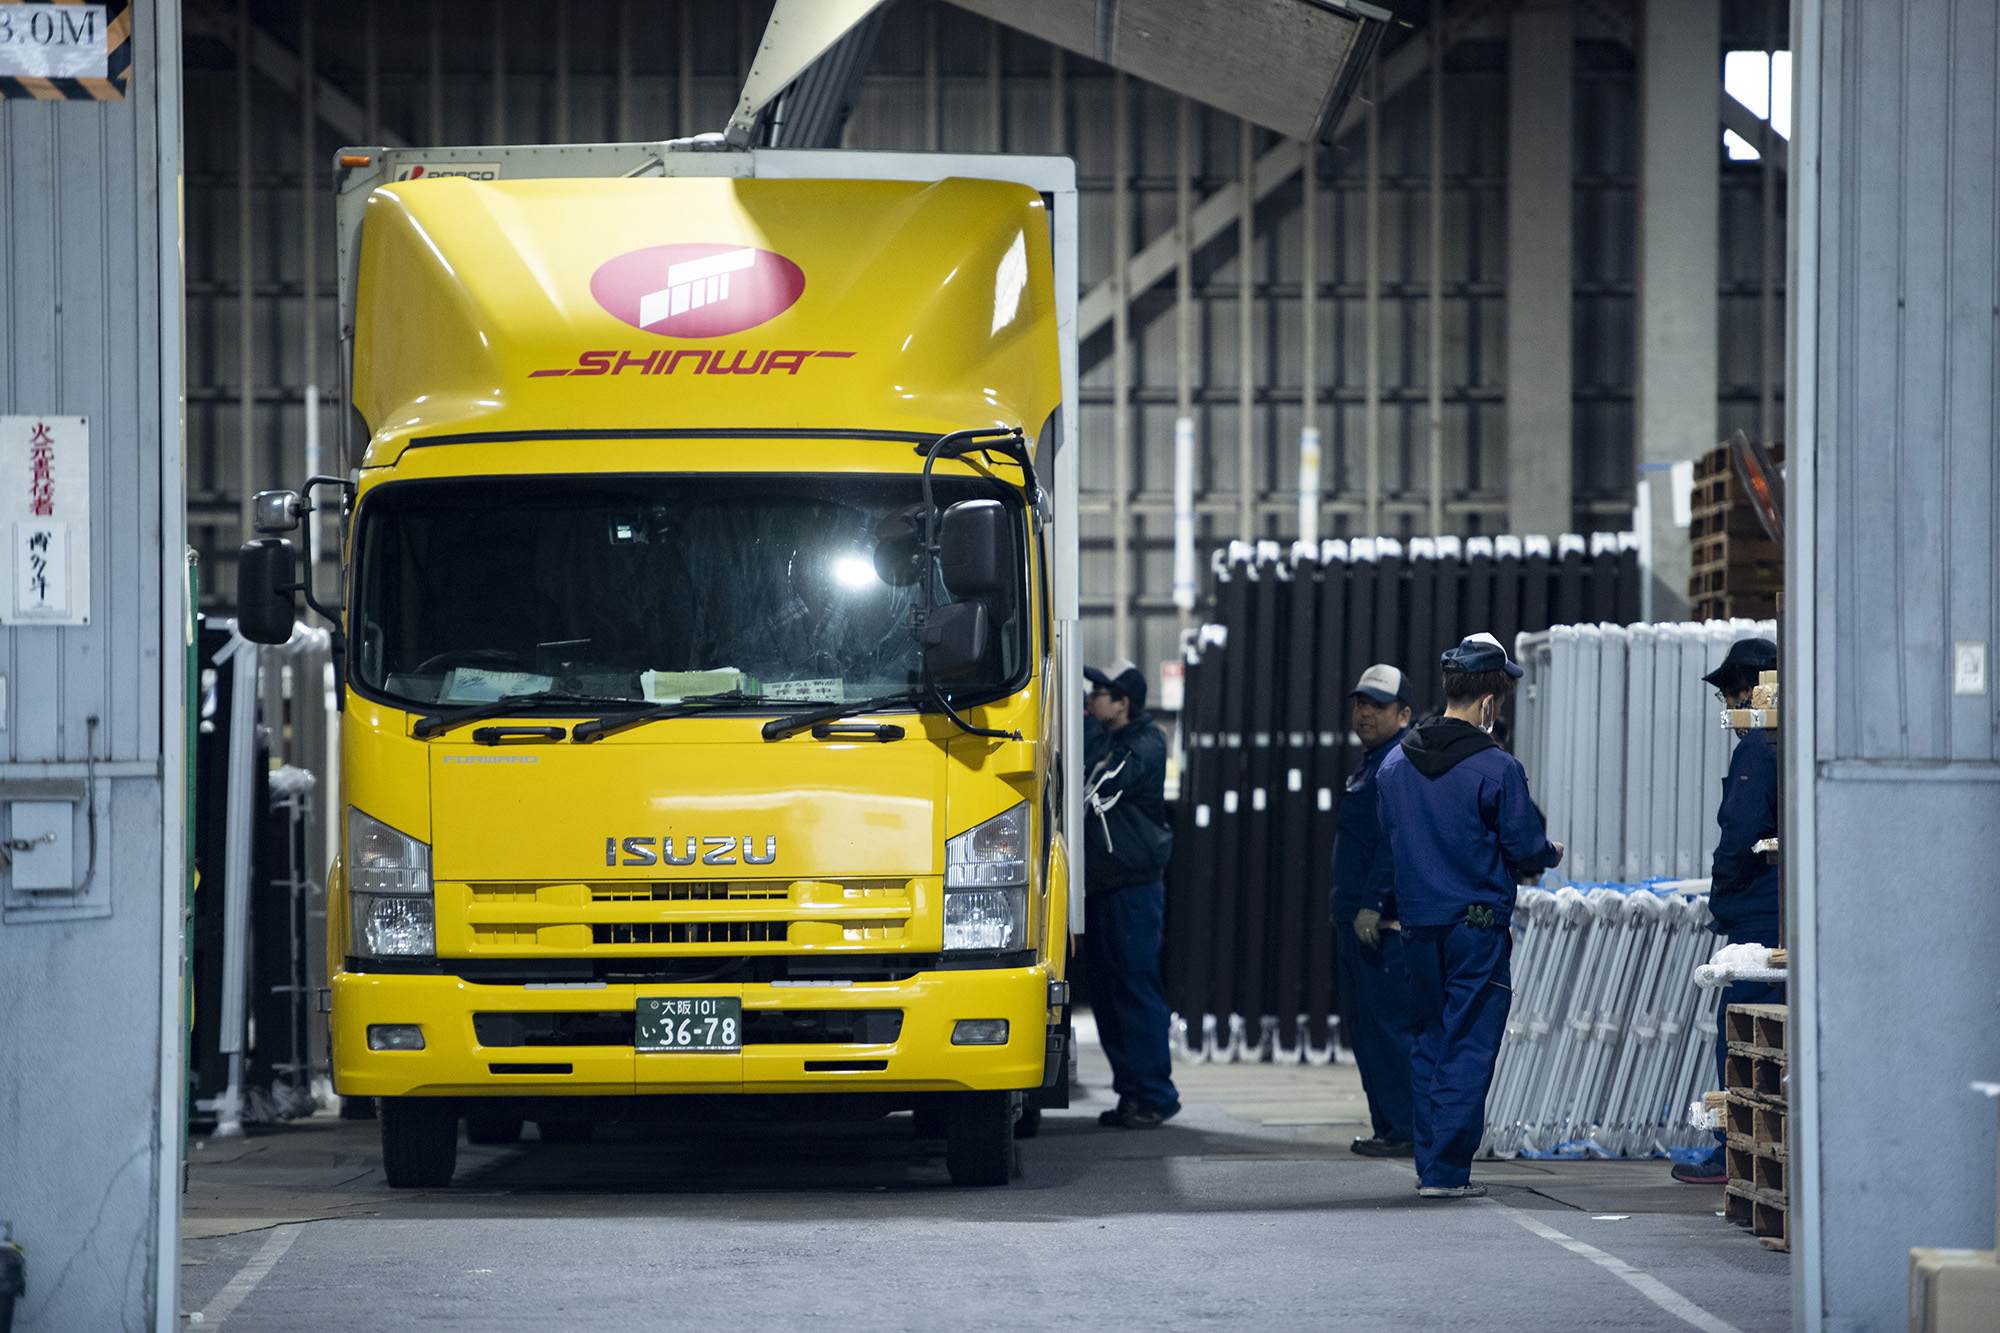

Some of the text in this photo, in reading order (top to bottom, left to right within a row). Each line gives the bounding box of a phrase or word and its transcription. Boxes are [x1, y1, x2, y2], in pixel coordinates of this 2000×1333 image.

[566, 350, 818, 376] SHINWA
[29, 422, 54, 516] 火元責任者
[443, 755, 538, 764] FORWARD
[606, 836, 776, 866] ISUZU
[641, 1018, 736, 1045] い 36-78
